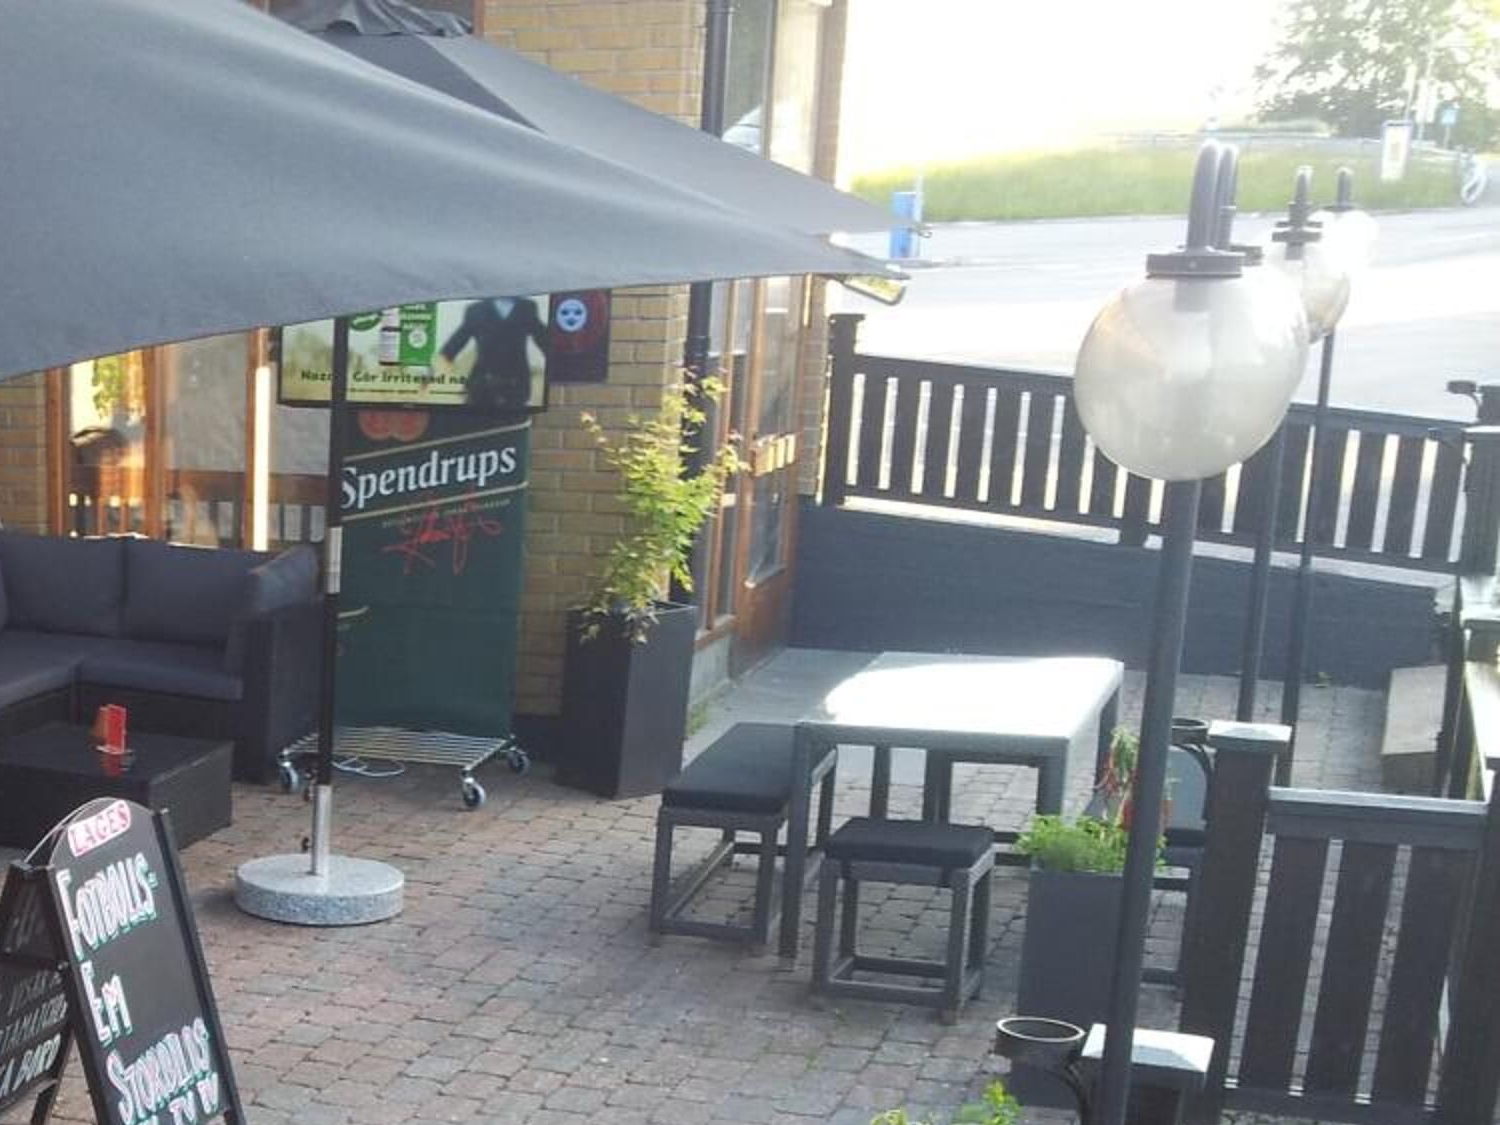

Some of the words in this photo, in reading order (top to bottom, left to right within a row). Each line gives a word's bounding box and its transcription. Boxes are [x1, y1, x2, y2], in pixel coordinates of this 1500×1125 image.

[341, 447, 517, 508] Spendrups
[11, 1032, 62, 1091] BORD
[196, 1071, 220, 1116] TV
